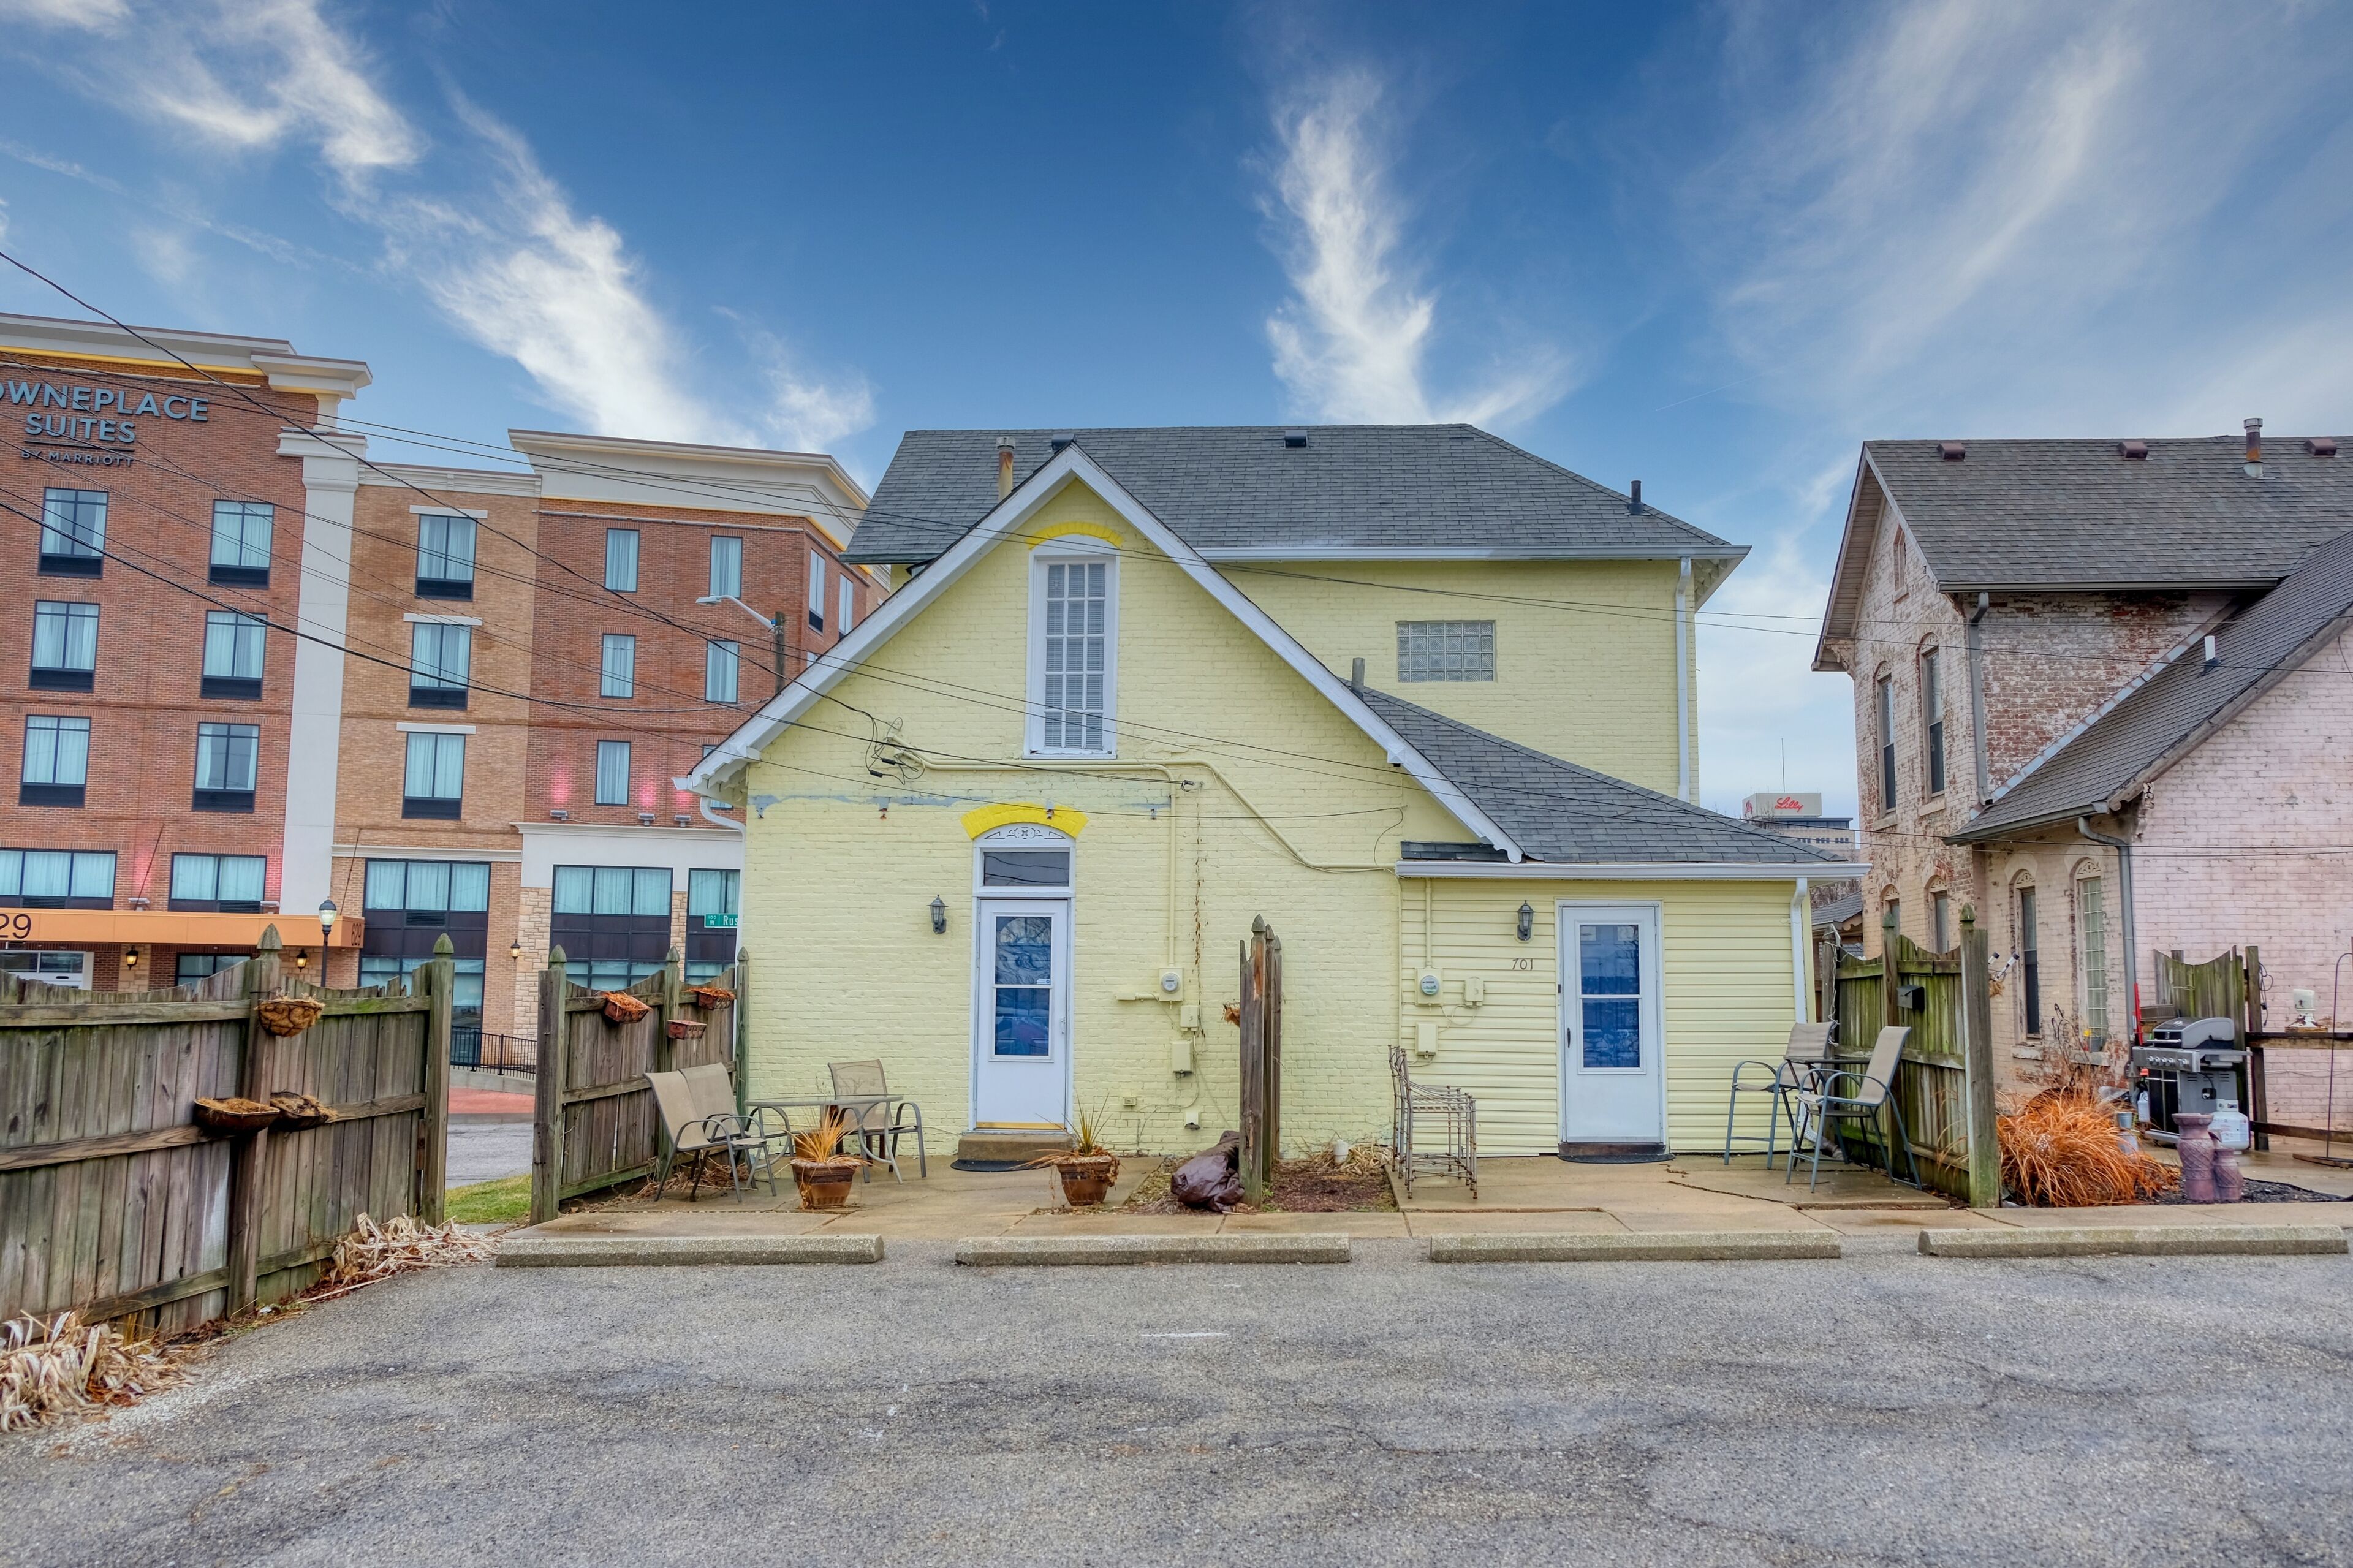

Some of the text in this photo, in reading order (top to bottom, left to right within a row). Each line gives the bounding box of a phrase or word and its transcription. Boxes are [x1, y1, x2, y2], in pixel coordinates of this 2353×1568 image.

[0, 380, 209, 422] WNEPLACE
[24, 413, 136, 443] SUITES
[21, 449, 134, 466] BY MARRIOTT
[1775, 797, 1803, 812] Lilly
[351, 923, 362, 946] 629
[1512, 958, 1533, 971] 701
